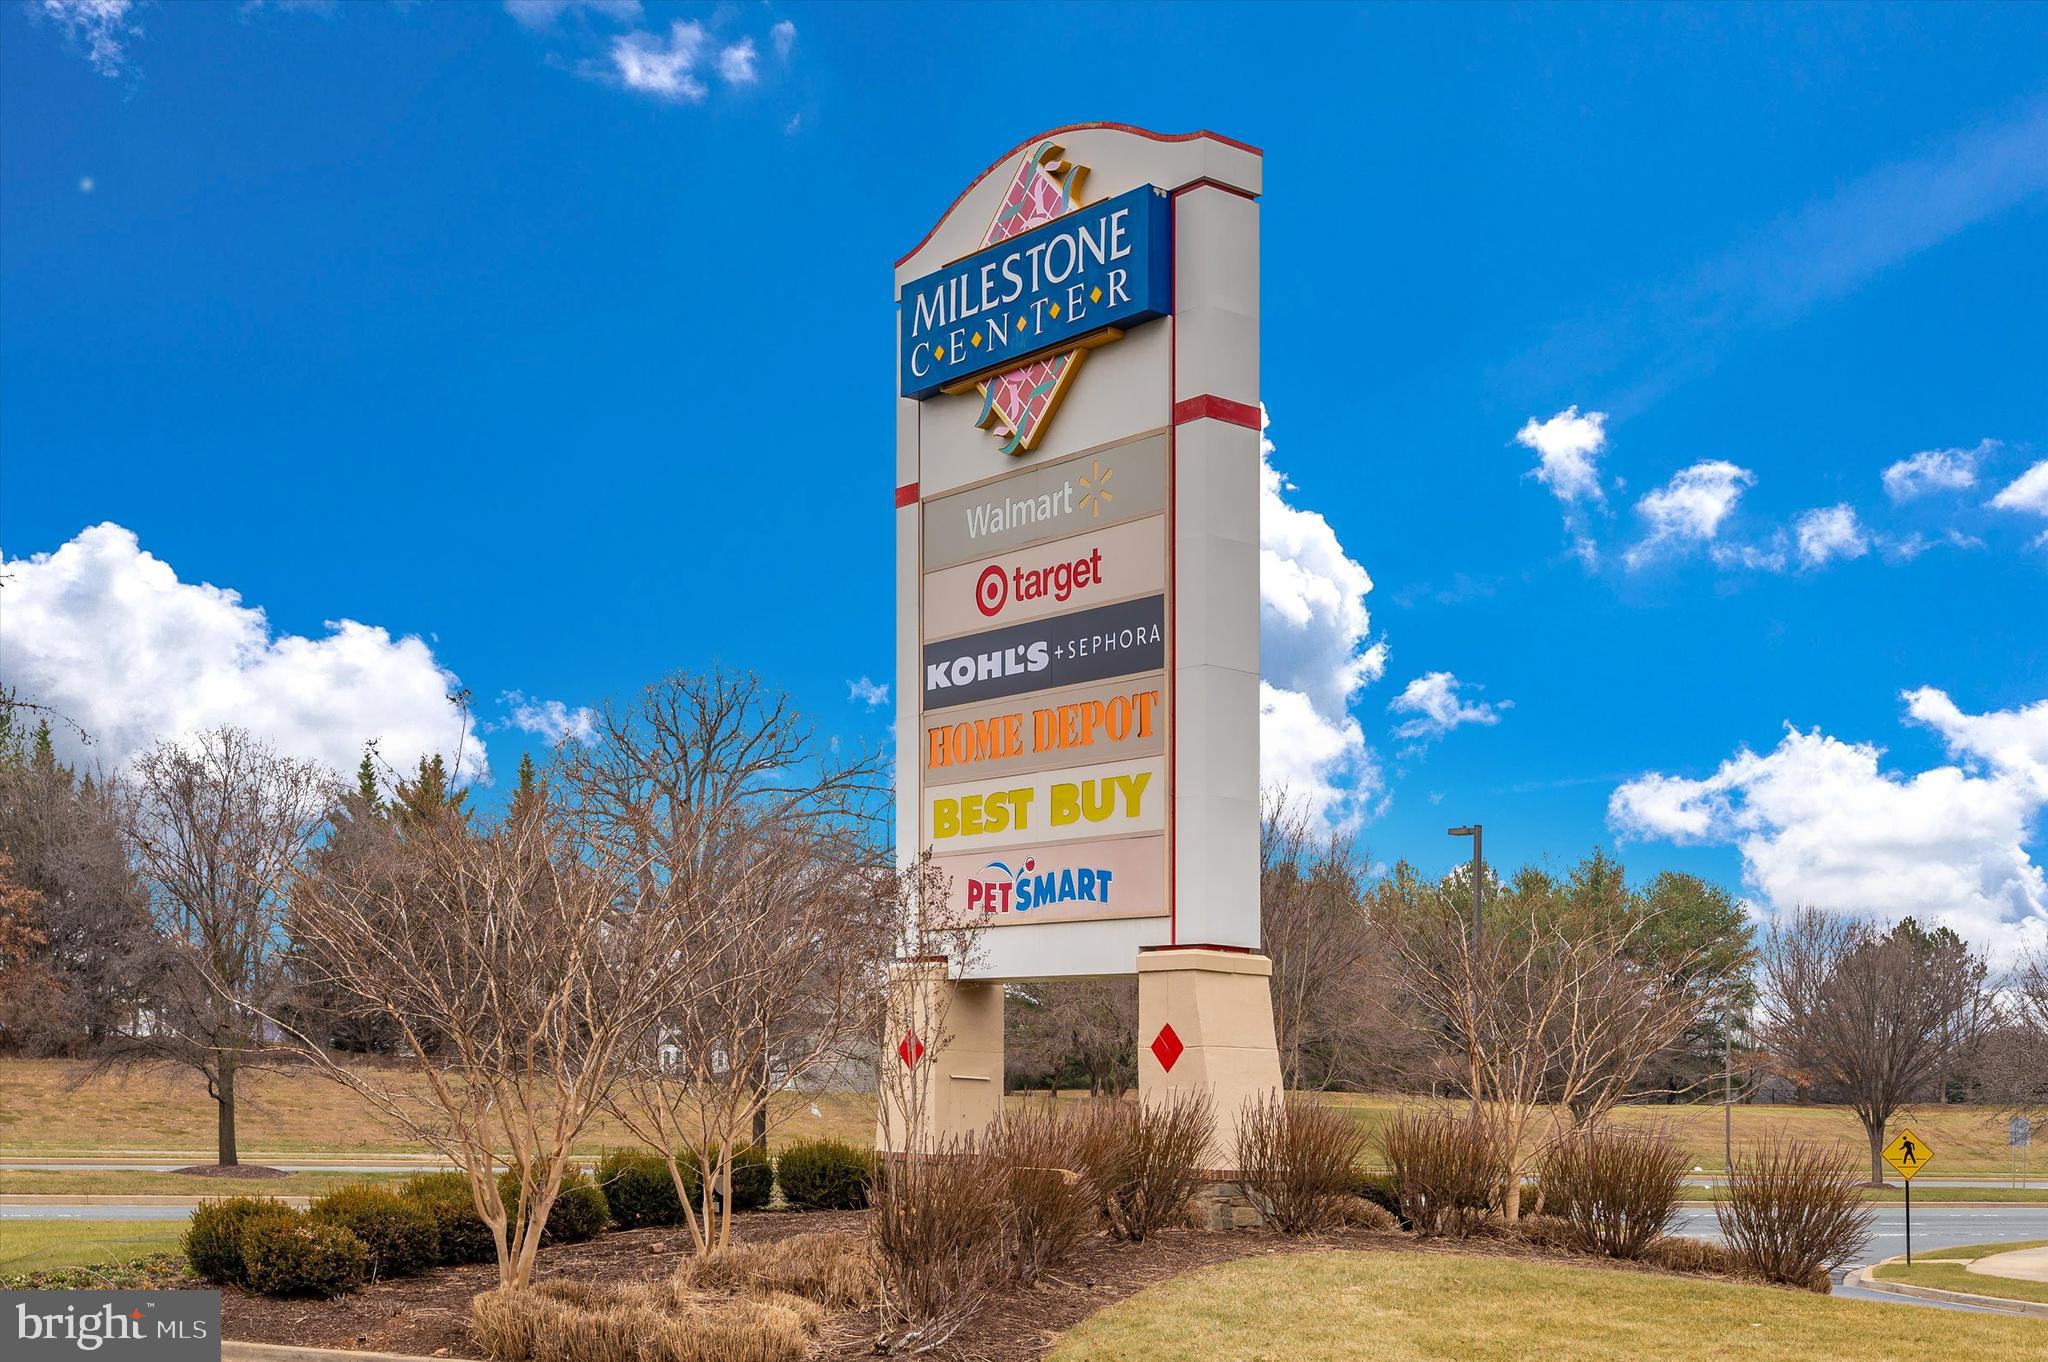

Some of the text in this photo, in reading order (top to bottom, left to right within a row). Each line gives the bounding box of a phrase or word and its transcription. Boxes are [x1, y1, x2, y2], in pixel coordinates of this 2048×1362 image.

[911, 208, 1131, 337] MILESTONE
[966, 480, 1073, 538] Walmart
[1013, 547, 1102, 602] target
[927, 641, 1049, 691] KOHL'S
[928, 690, 1160, 769] HOME DEPOT
[933, 772, 1153, 839] BEST BUY
